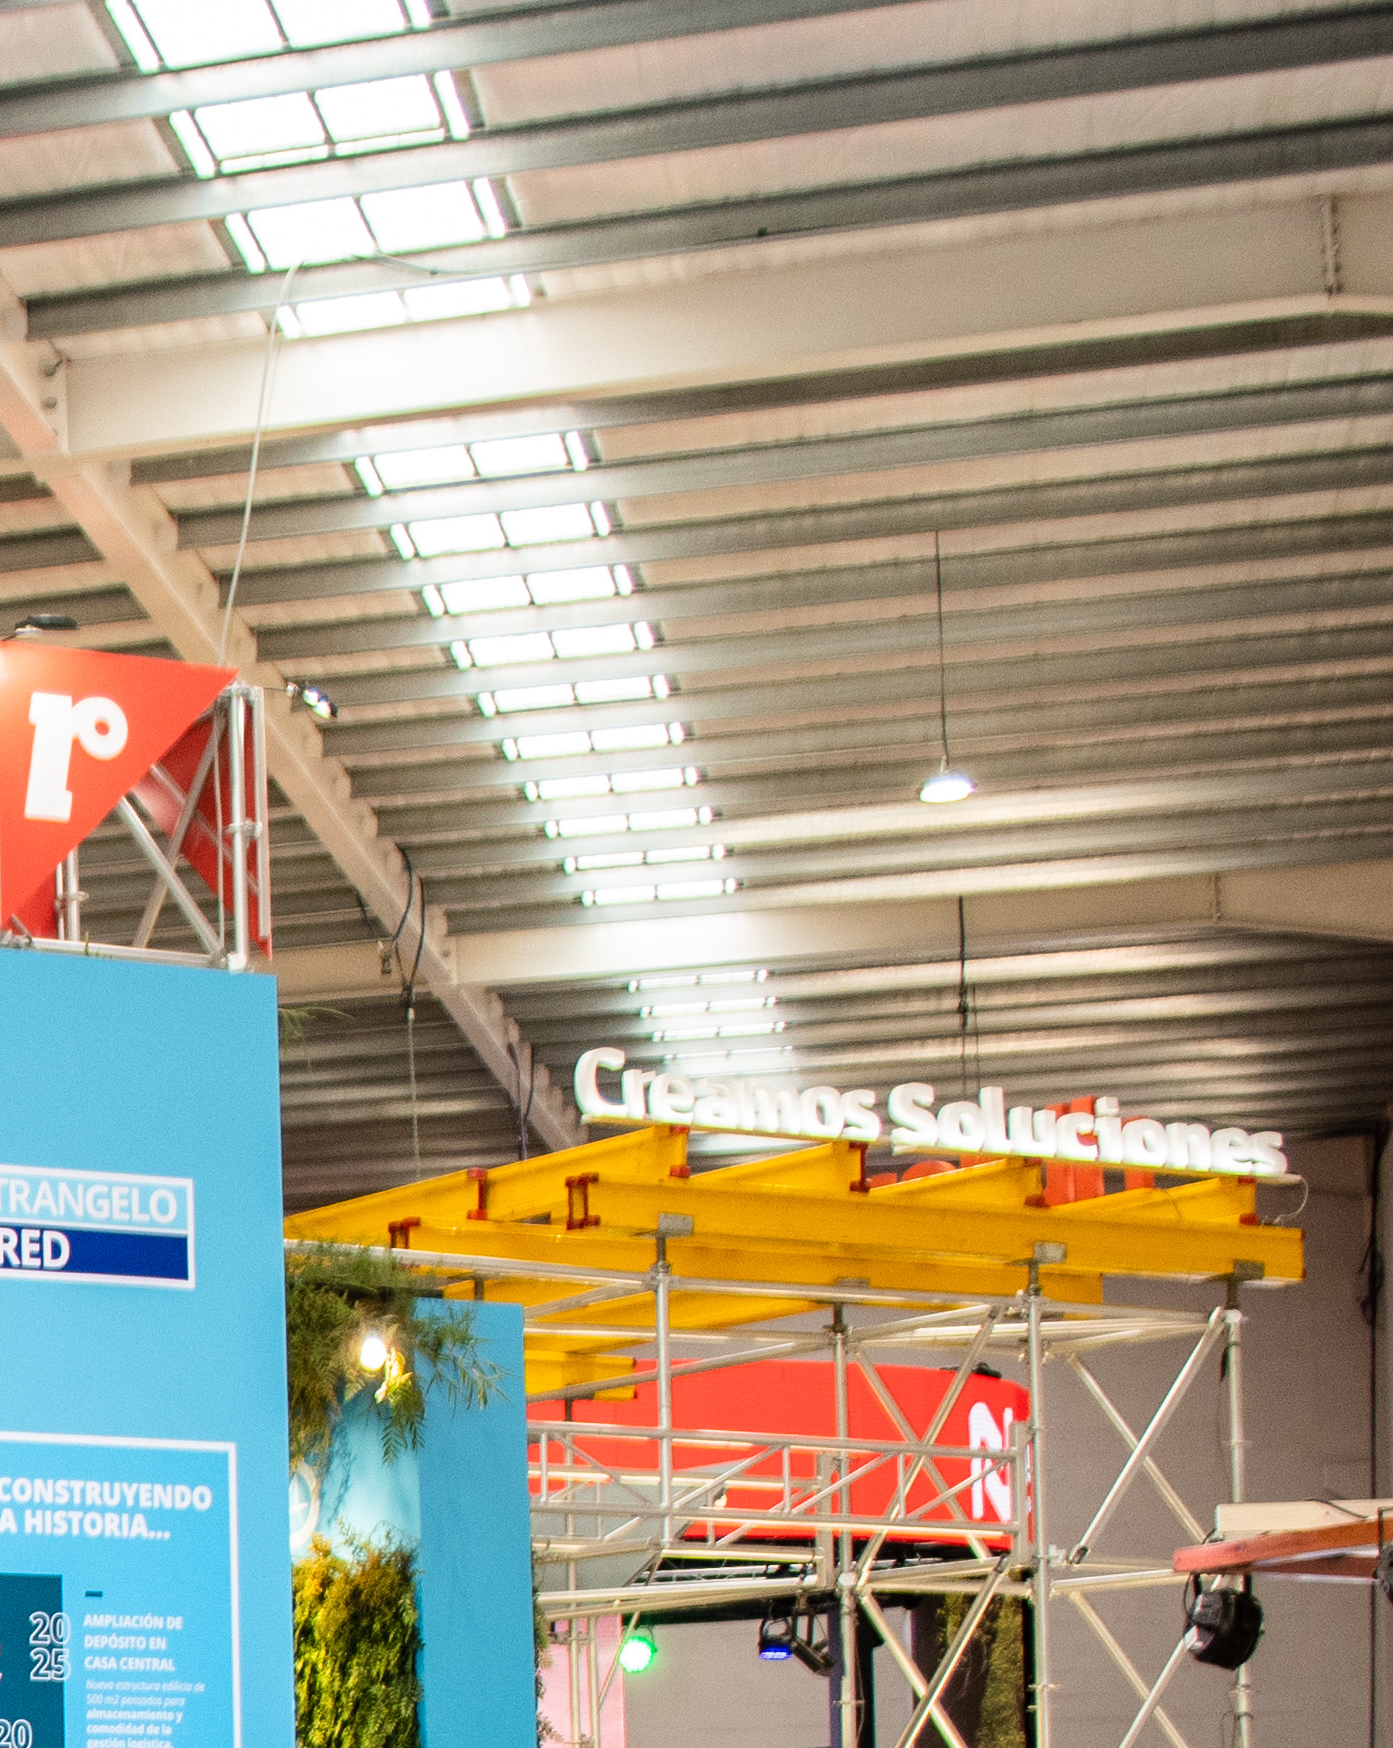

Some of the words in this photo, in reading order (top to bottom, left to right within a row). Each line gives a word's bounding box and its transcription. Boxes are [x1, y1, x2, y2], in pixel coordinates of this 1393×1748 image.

[574, 1047, 882, 1141] Creamos
[889, 1082, 1288, 1176] Soluciones
[24, 1509, 171, 1540] HISTORIA...
[29, 1612, 70, 1645] 20
[84, 1613, 163, 1630] AMPLIACIÓN
[167, 1616, 183, 1630] DE
[84, 1634, 146, 1649] DEPÓSITO
[149, 1637, 166, 1650] EN
[30, 1648, 71, 1681] 25
[84, 1657, 117, 1670] CASA
[120, 1657, 175, 1671] CENTRAL
